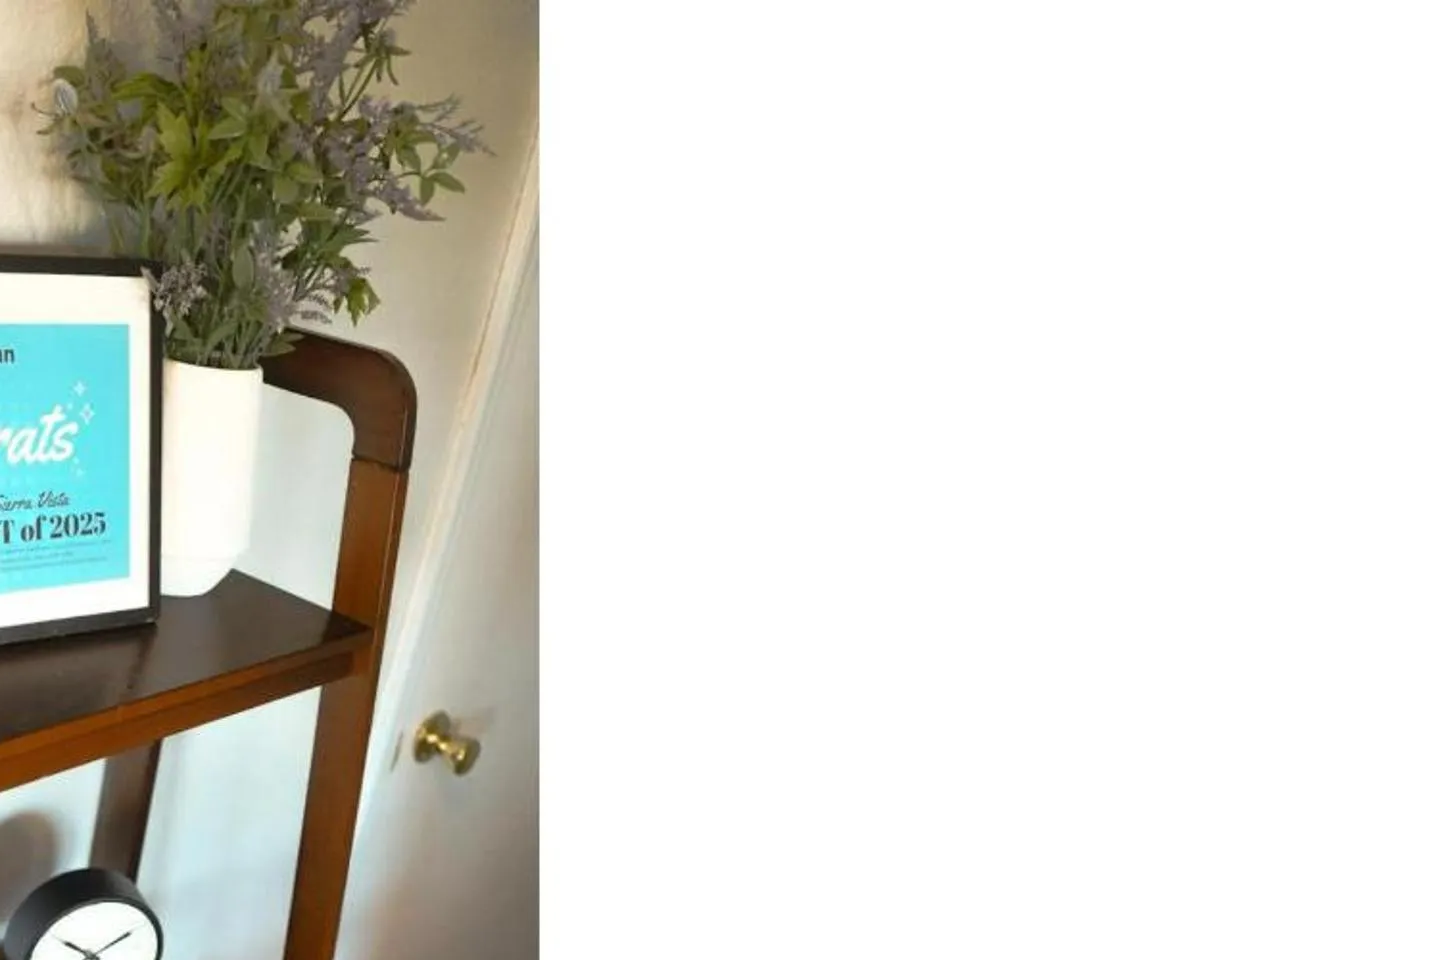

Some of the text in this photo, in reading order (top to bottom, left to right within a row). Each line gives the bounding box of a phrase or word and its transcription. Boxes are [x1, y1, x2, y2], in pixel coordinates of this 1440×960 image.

[38, 490, 71, 508] Vista
[20, 514, 47, 542] of
[49, 511, 107, 539] 2025
